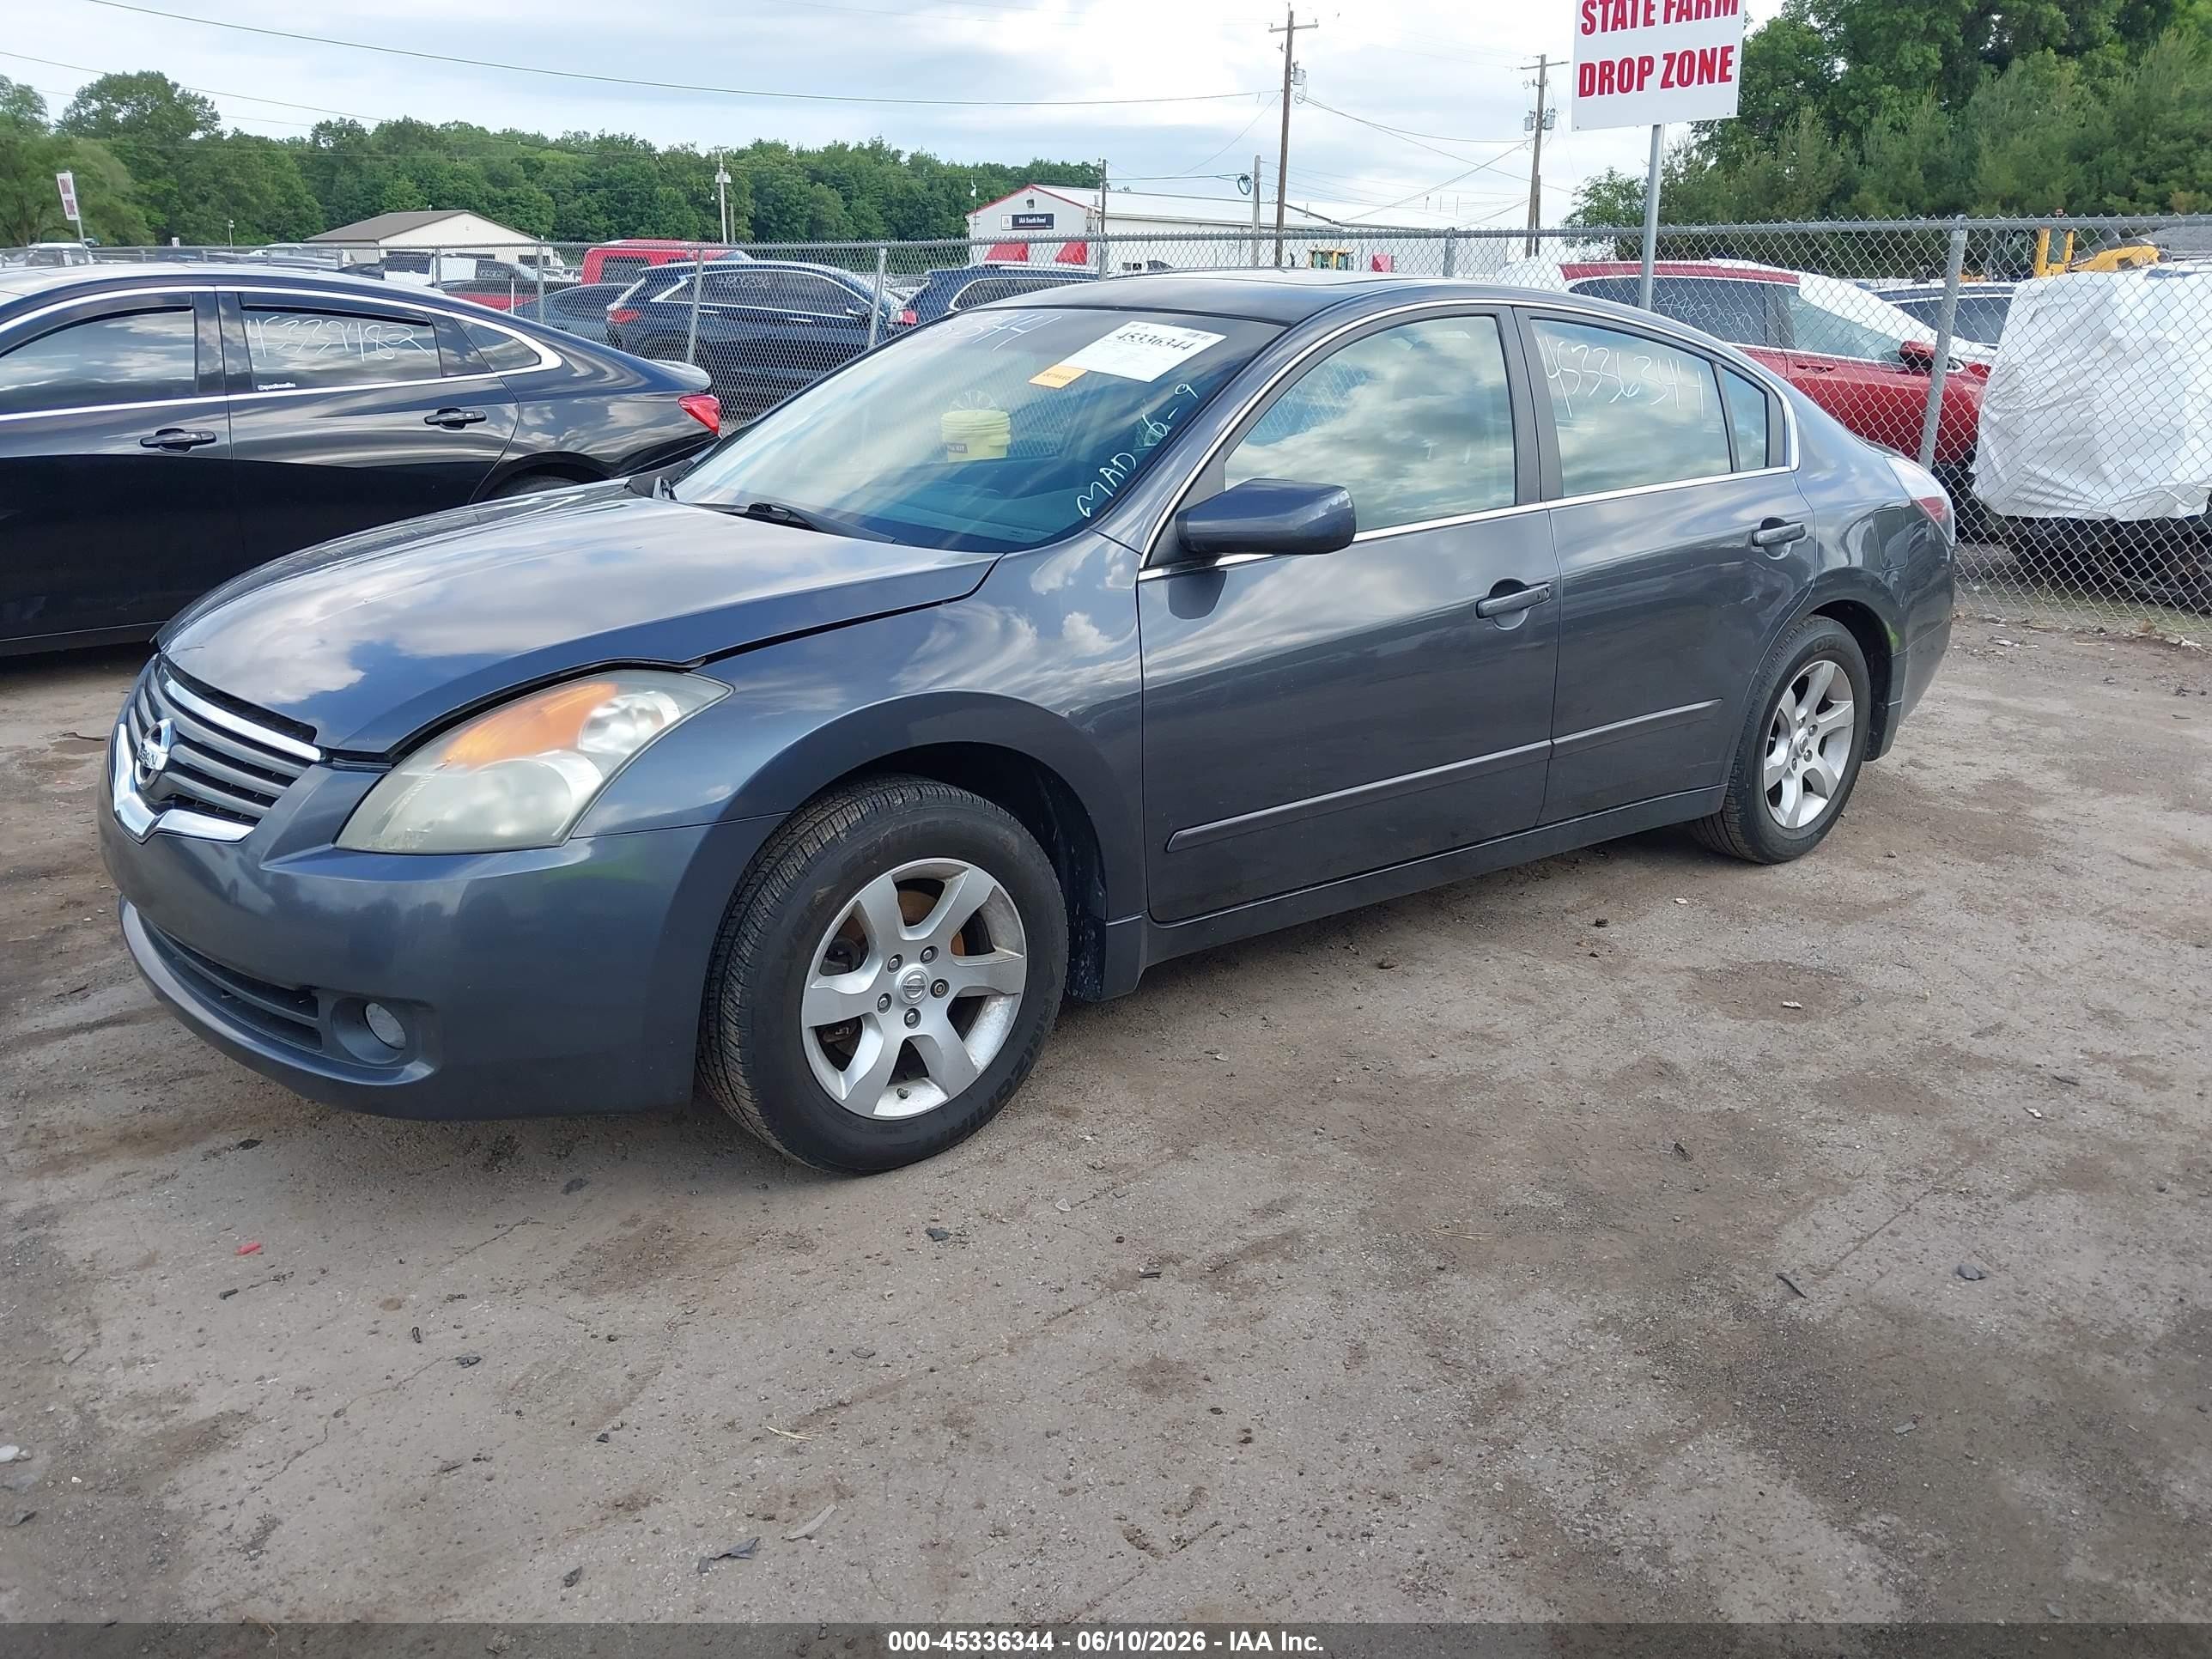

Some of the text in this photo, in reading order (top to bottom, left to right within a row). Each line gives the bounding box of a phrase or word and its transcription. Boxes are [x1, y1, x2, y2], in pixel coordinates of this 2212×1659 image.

[1581, 0, 1656, 35] STATE
[1578, 46, 1735, 98] DROP ZONE
[1077, 453, 1137, 518] MAD
